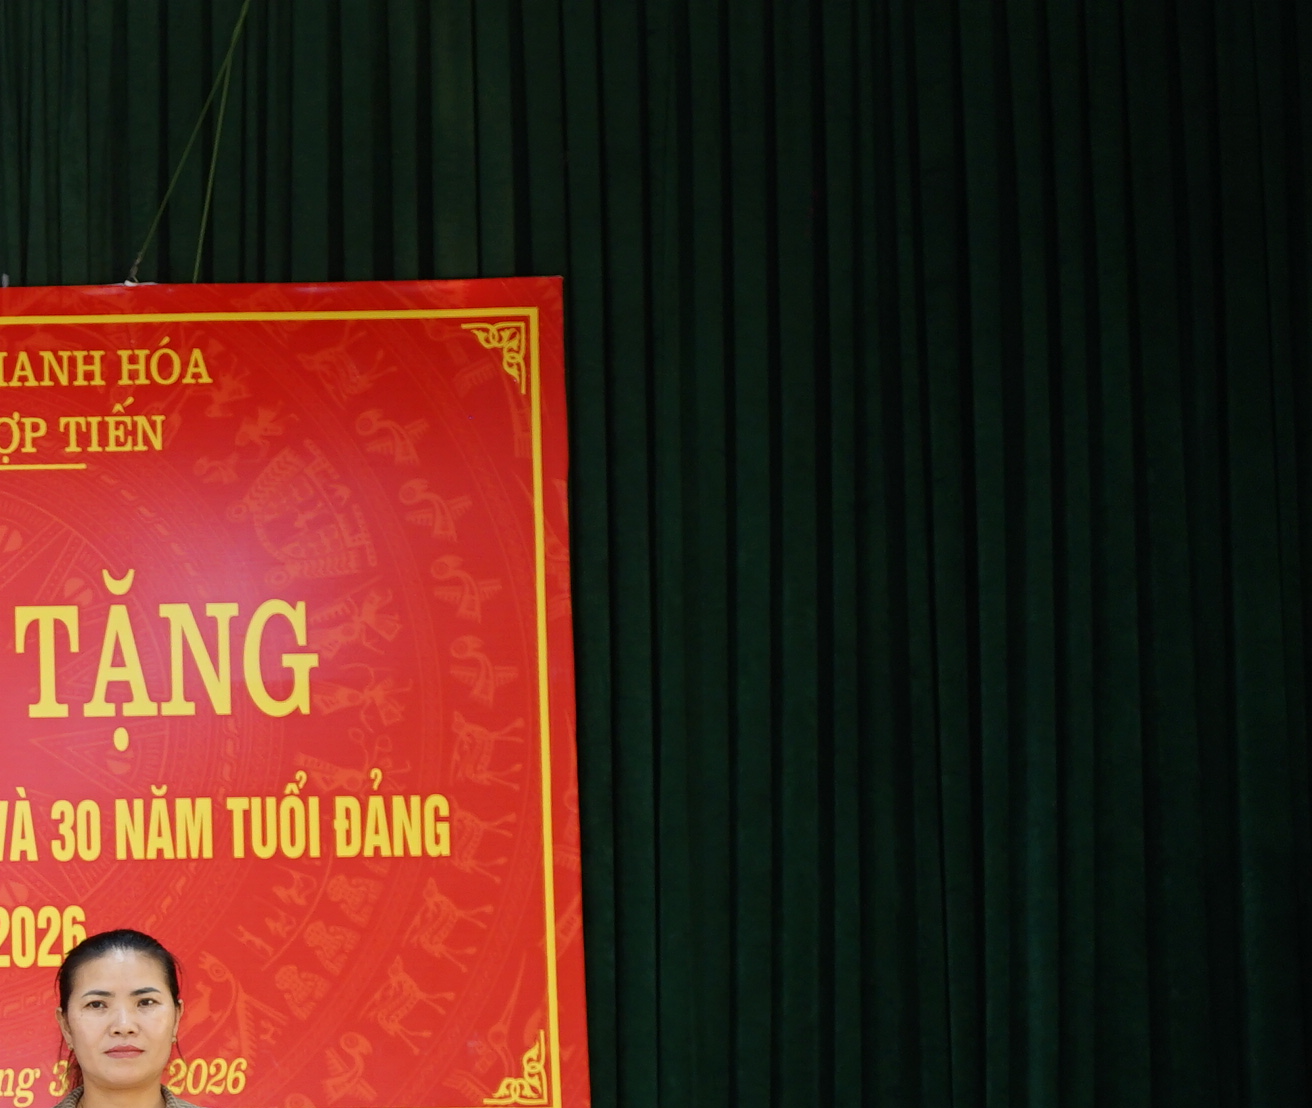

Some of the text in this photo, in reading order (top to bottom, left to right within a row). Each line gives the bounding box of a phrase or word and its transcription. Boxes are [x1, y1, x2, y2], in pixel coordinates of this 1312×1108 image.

[120, 340, 210, 384] HÓA
[61, 399, 163, 451] TIẾN
[15, 570, 318, 751] TẶNG
[51, 800, 100, 861] 30
[116, 785, 212, 859] NĂM
[227, 771, 320, 858] TUỔI
[334, 769, 449, 857] ĐẢNG
[167, 1058, 247, 1094] 2026
